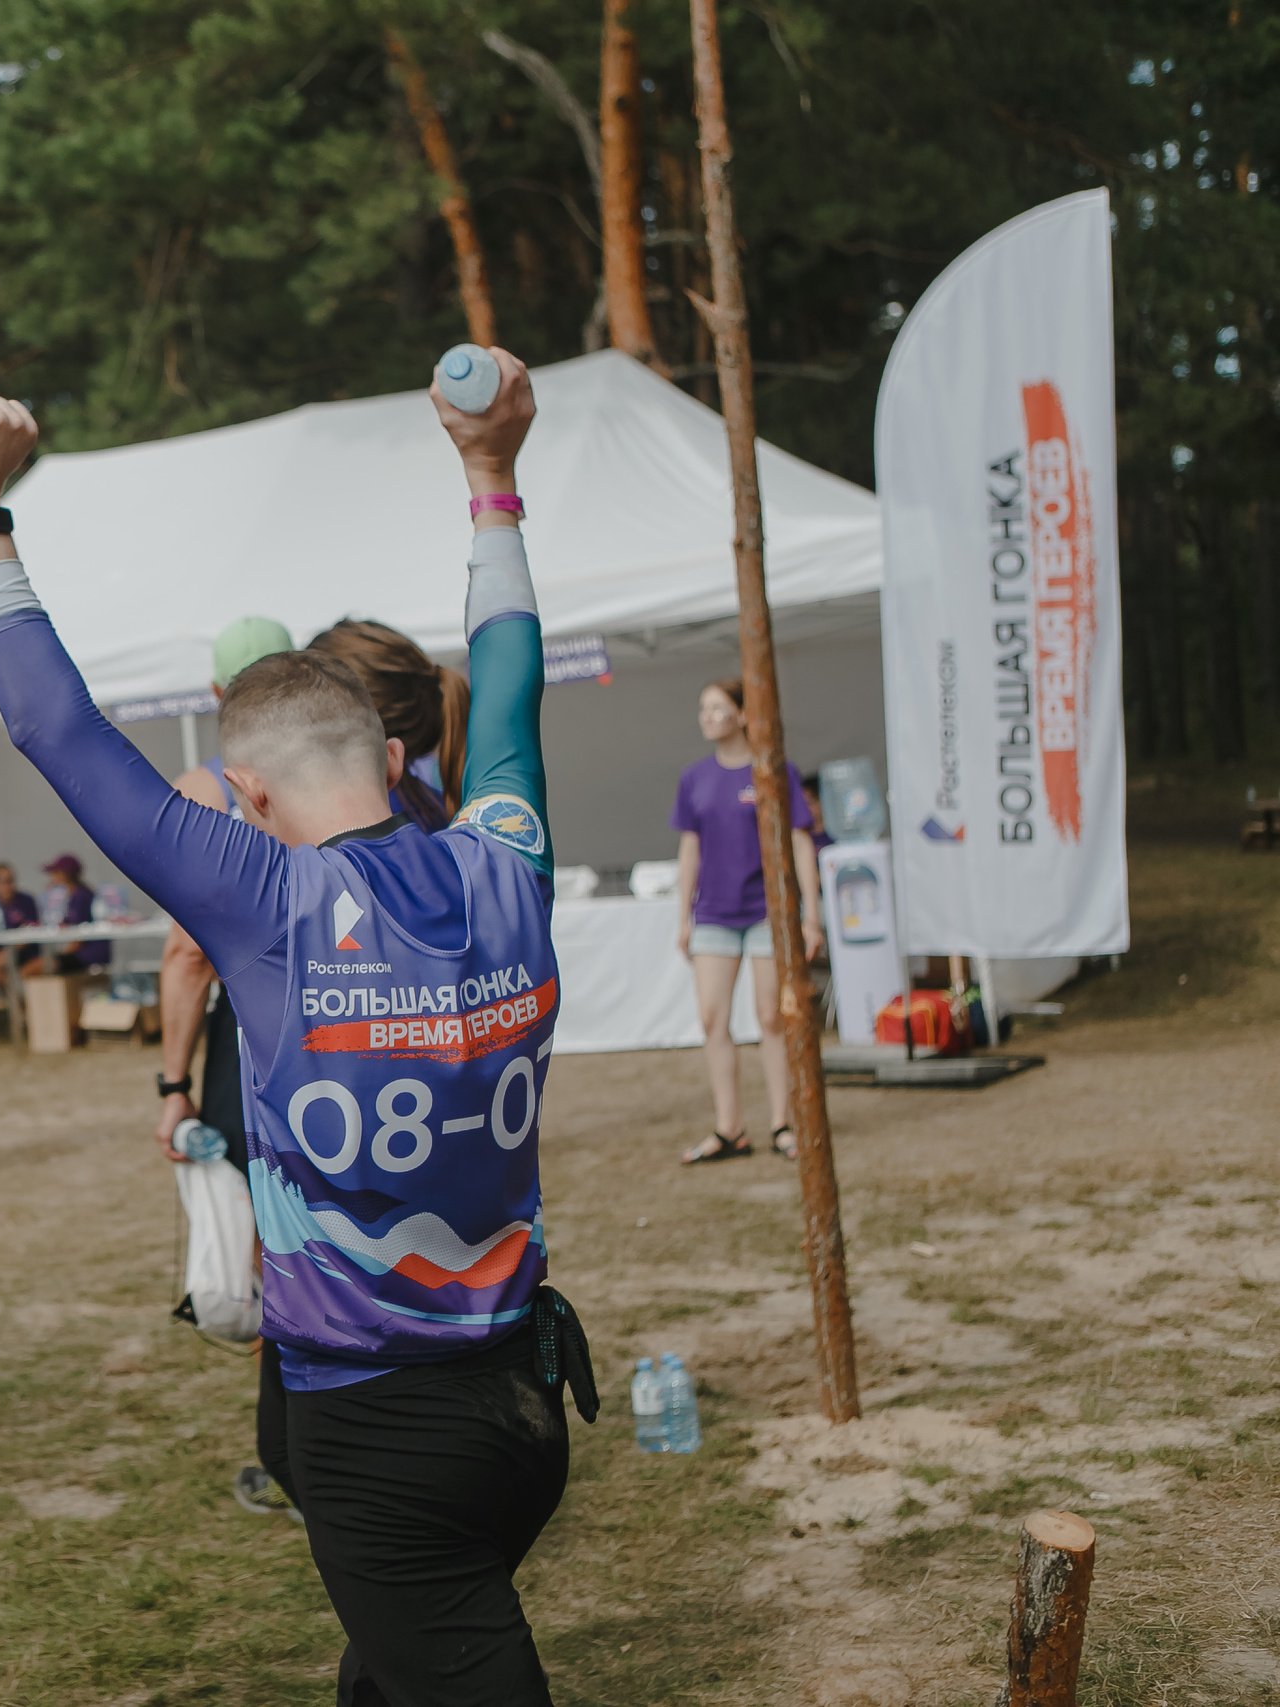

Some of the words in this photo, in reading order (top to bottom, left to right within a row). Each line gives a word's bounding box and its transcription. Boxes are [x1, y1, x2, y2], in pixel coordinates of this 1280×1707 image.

[988, 450, 1027, 603] ГОНКА
[1031, 437, 1074, 602] ГЕРОЕВ
[937, 641, 959, 810] Ростелеком
[995, 620, 1034, 844] БОЛЬШАЯ
[1038, 610, 1076, 752] ВРЕМЯ
[302, 985, 458, 1017] БОЛЬШАЯ
[307, 960, 392, 975] Ростелеком
[370, 1019, 464, 1049] ВРЕМЯ
